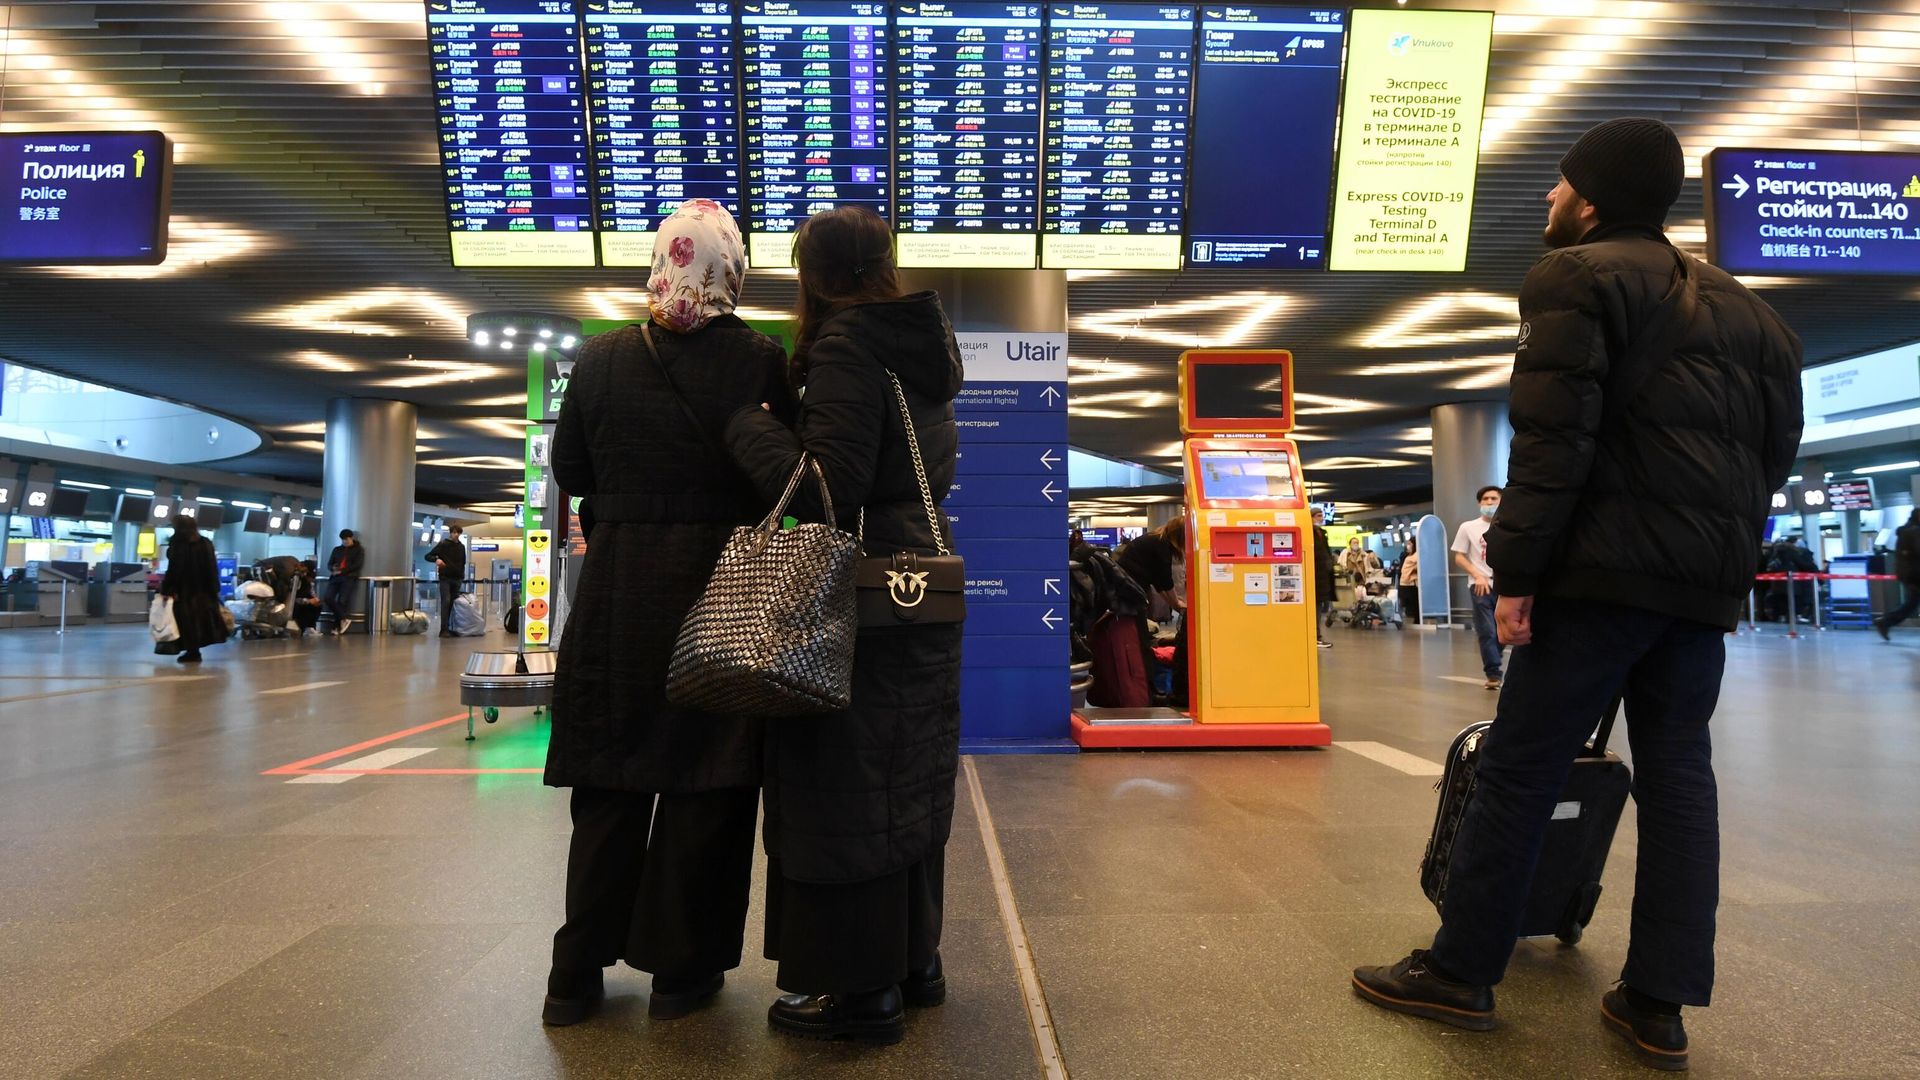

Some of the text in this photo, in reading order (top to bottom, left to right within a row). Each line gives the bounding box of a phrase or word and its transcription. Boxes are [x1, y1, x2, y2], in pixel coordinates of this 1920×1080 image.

[1412, 38, 1454, 48] Vnukovo
[1386, 78, 1448, 91] Экспресс
[1370, 94, 1461, 105] тестирование
[1373, 107, 1455, 118] на COVID-19
[1364, 123, 1461, 134] в терминале D
[59, 144, 80, 152] floor
[1375, 137, 1446, 148] терминале
[1451, 137, 1459, 147] A
[1786, 161, 1805, 169] floor
[23, 162, 125, 181] Полиция
[21, 187, 67, 200] Police
[1757, 177, 1897, 200] Регистрация,
[1347, 191, 1463, 203] Express COVID-19
[20, 207, 60, 220] 警务室
[1382, 205, 1427, 218] Testing
[1758, 199, 1908, 220] стойки 71...140
[1370, 219, 1436, 229] Terminal D
[1760, 224, 1821, 238] Check-in
[1826, 227, 1887, 239] counters
[1354, 233, 1448, 243] and Terminal A
[1761, 244, 1810, 257] 值机柜台
[1007, 341, 1060, 361] Utair
[994, 388, 1019, 397] рейсы)
[985, 588, 1008, 596] flights)
